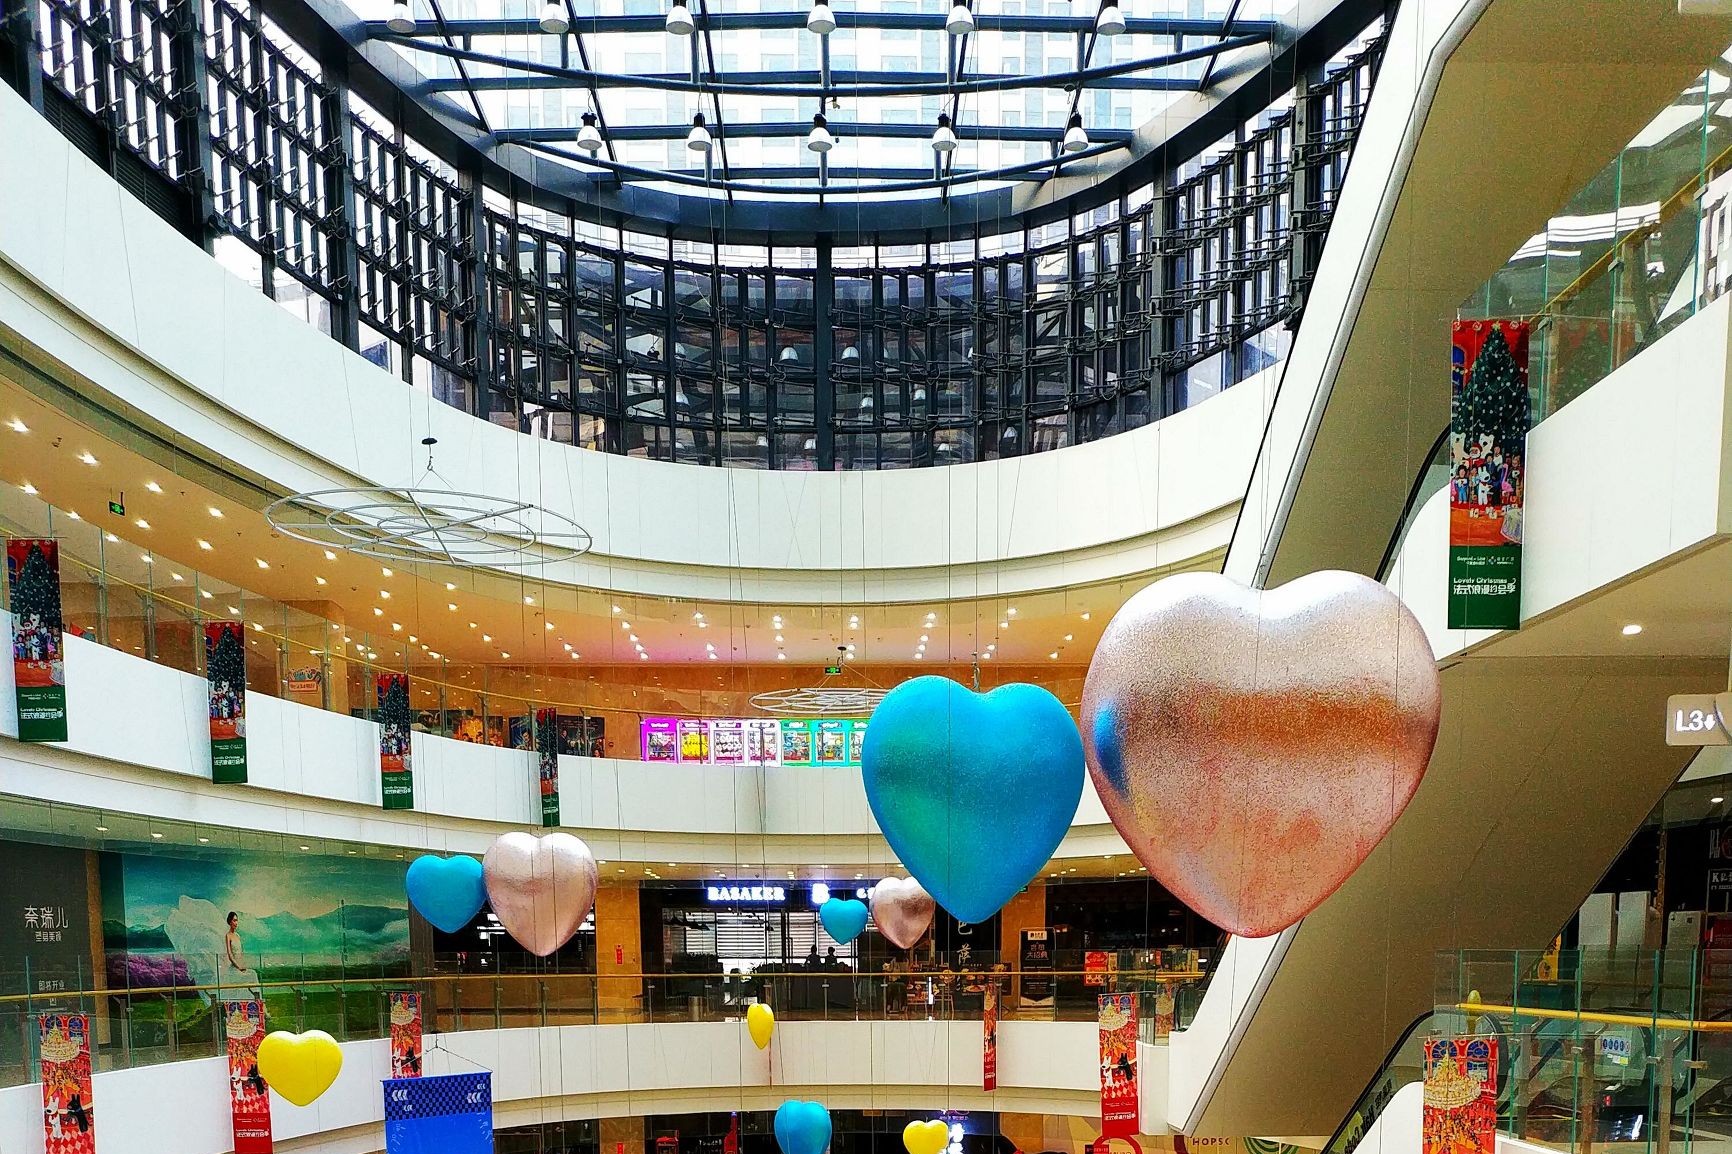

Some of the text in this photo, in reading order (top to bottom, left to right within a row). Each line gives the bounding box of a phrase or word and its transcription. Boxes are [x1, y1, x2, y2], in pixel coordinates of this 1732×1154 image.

[1676, 709, 1704, 732] L3
[707, 886, 786, 901] BASAKER
[24, 905, 69, 929] 奈瑞儿
